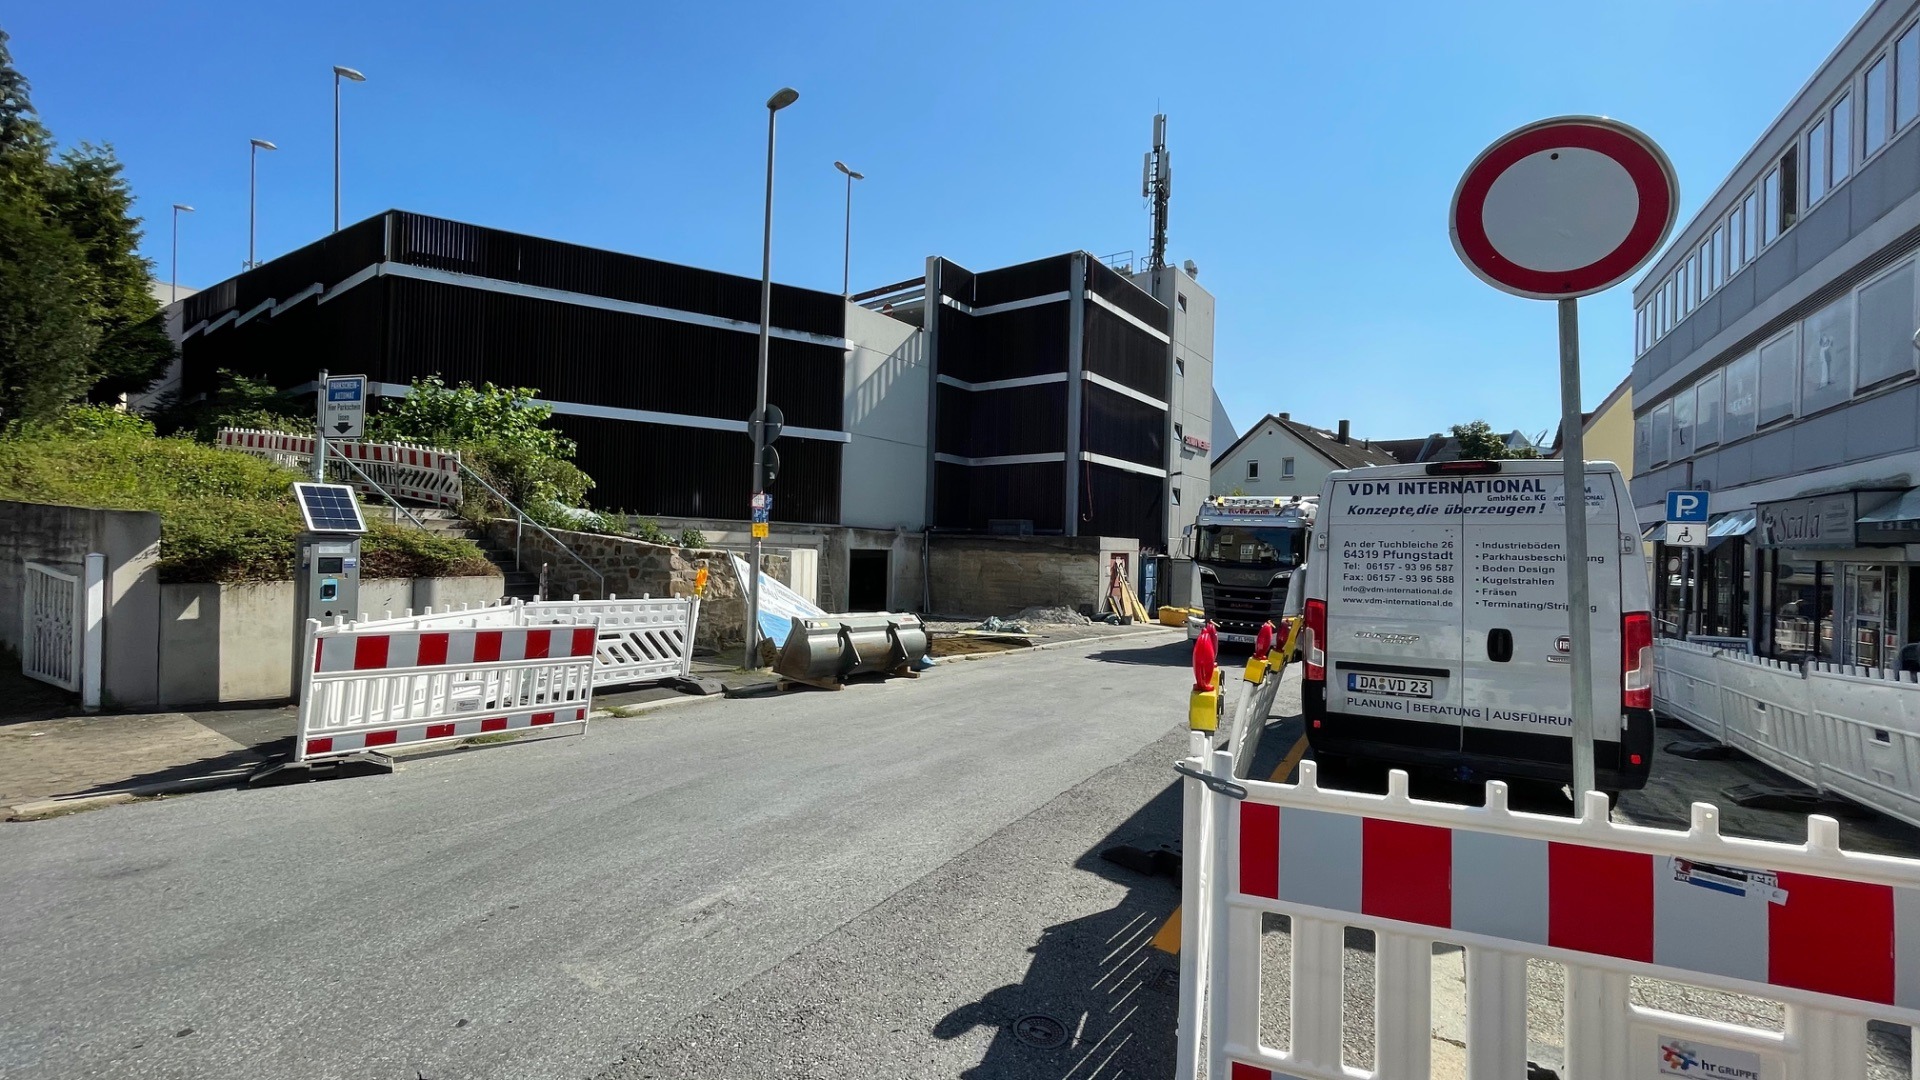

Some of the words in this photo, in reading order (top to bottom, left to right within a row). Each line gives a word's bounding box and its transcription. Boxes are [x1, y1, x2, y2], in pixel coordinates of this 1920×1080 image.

[1348, 482, 1390, 496] VDM
[1398, 479, 1546, 494] INTERNATIONAL
[1444, 503, 1536, 517] überzeugen
[1676, 494, 1699, 518] P
[1776, 501, 1820, 542] Scala
[1378, 541, 1438, 549] Tuchbleiche
[1441, 541, 1454, 549] 26
[1482, 542, 1561, 550] Industrieböden
[1343, 550, 1379, 559] 64319
[1383, 550, 1454, 562] Pfungstadt
[1343, 562, 1360, 570] Tel:
[1366, 562, 1395, 571] 06157
[1405, 563, 1417, 571] 93
[1420, 563, 1432, 571] 96
[1435, 564, 1454, 572] 587
[1482, 565, 1515, 573] Boden
[1518, 565, 1555, 575] Design
[1343, 573, 1364, 581] Fax:
[1366, 573, 1396, 582] 06157
[1405, 574, 1418, 583] 93
[1420, 575, 1433, 583] 96
[1436, 575, 1455, 584] 588
[1482, 576, 1555, 586] Kugelstrahlen
[1342, 586, 1453, 596] info@vdm-international.de
[1482, 588, 1517, 596] Fräsen
[1342, 597, 1453, 607] www.vdm-international.de
[1360, 676, 1377, 690] DA
[1388, 678, 1406, 692] VD
[1410, 680, 1428, 694] 23
[1347, 697, 1402, 710] PLANUNG
[1413, 703, 1480, 718] BERATUNG
[1701, 1059, 1717, 1072] hr
[1718, 1065, 1758, 1080] GRUPPE
